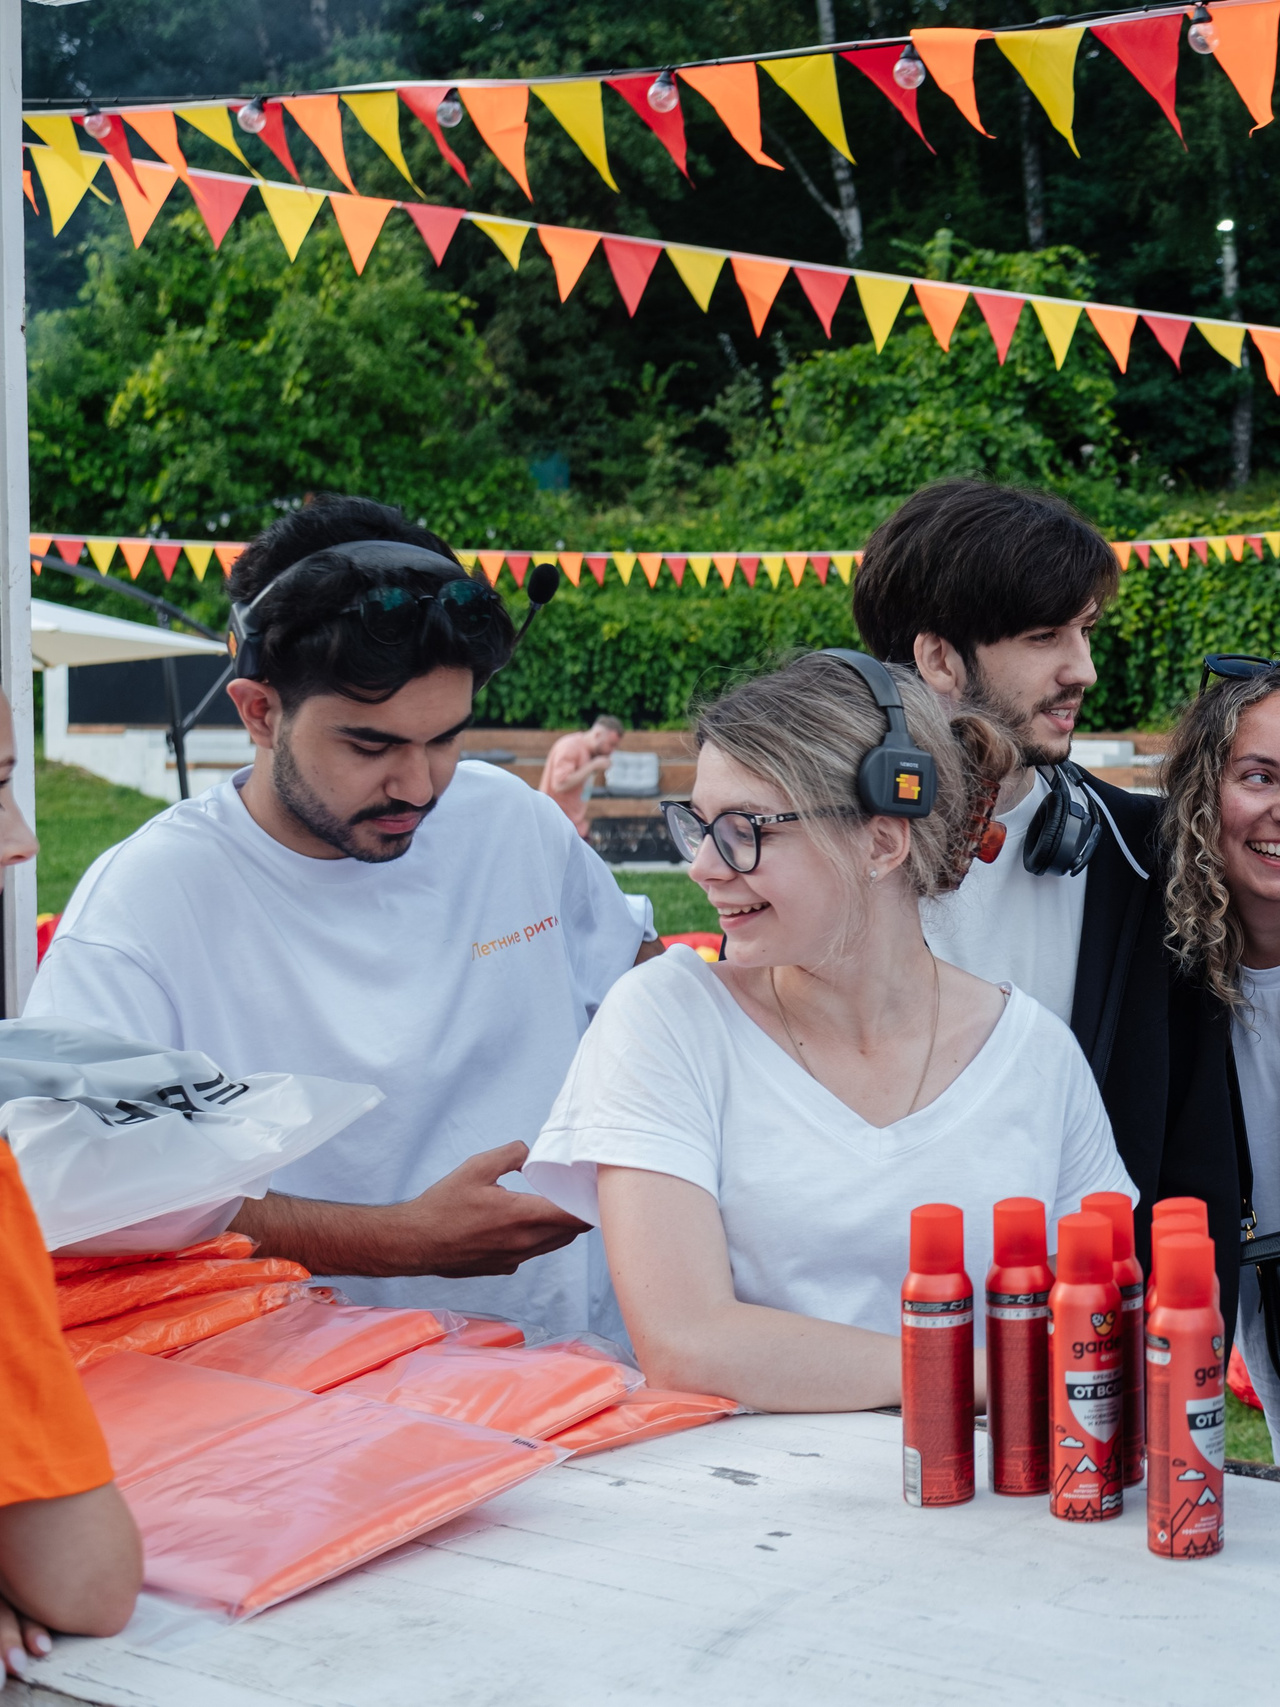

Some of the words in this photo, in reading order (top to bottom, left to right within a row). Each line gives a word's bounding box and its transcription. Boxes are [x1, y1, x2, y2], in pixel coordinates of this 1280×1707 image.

[471, 931, 521, 961] Летние
[1073, 1386, 1095, 1399] ОТ
[1195, 1413, 1214, 1428] ОТ
